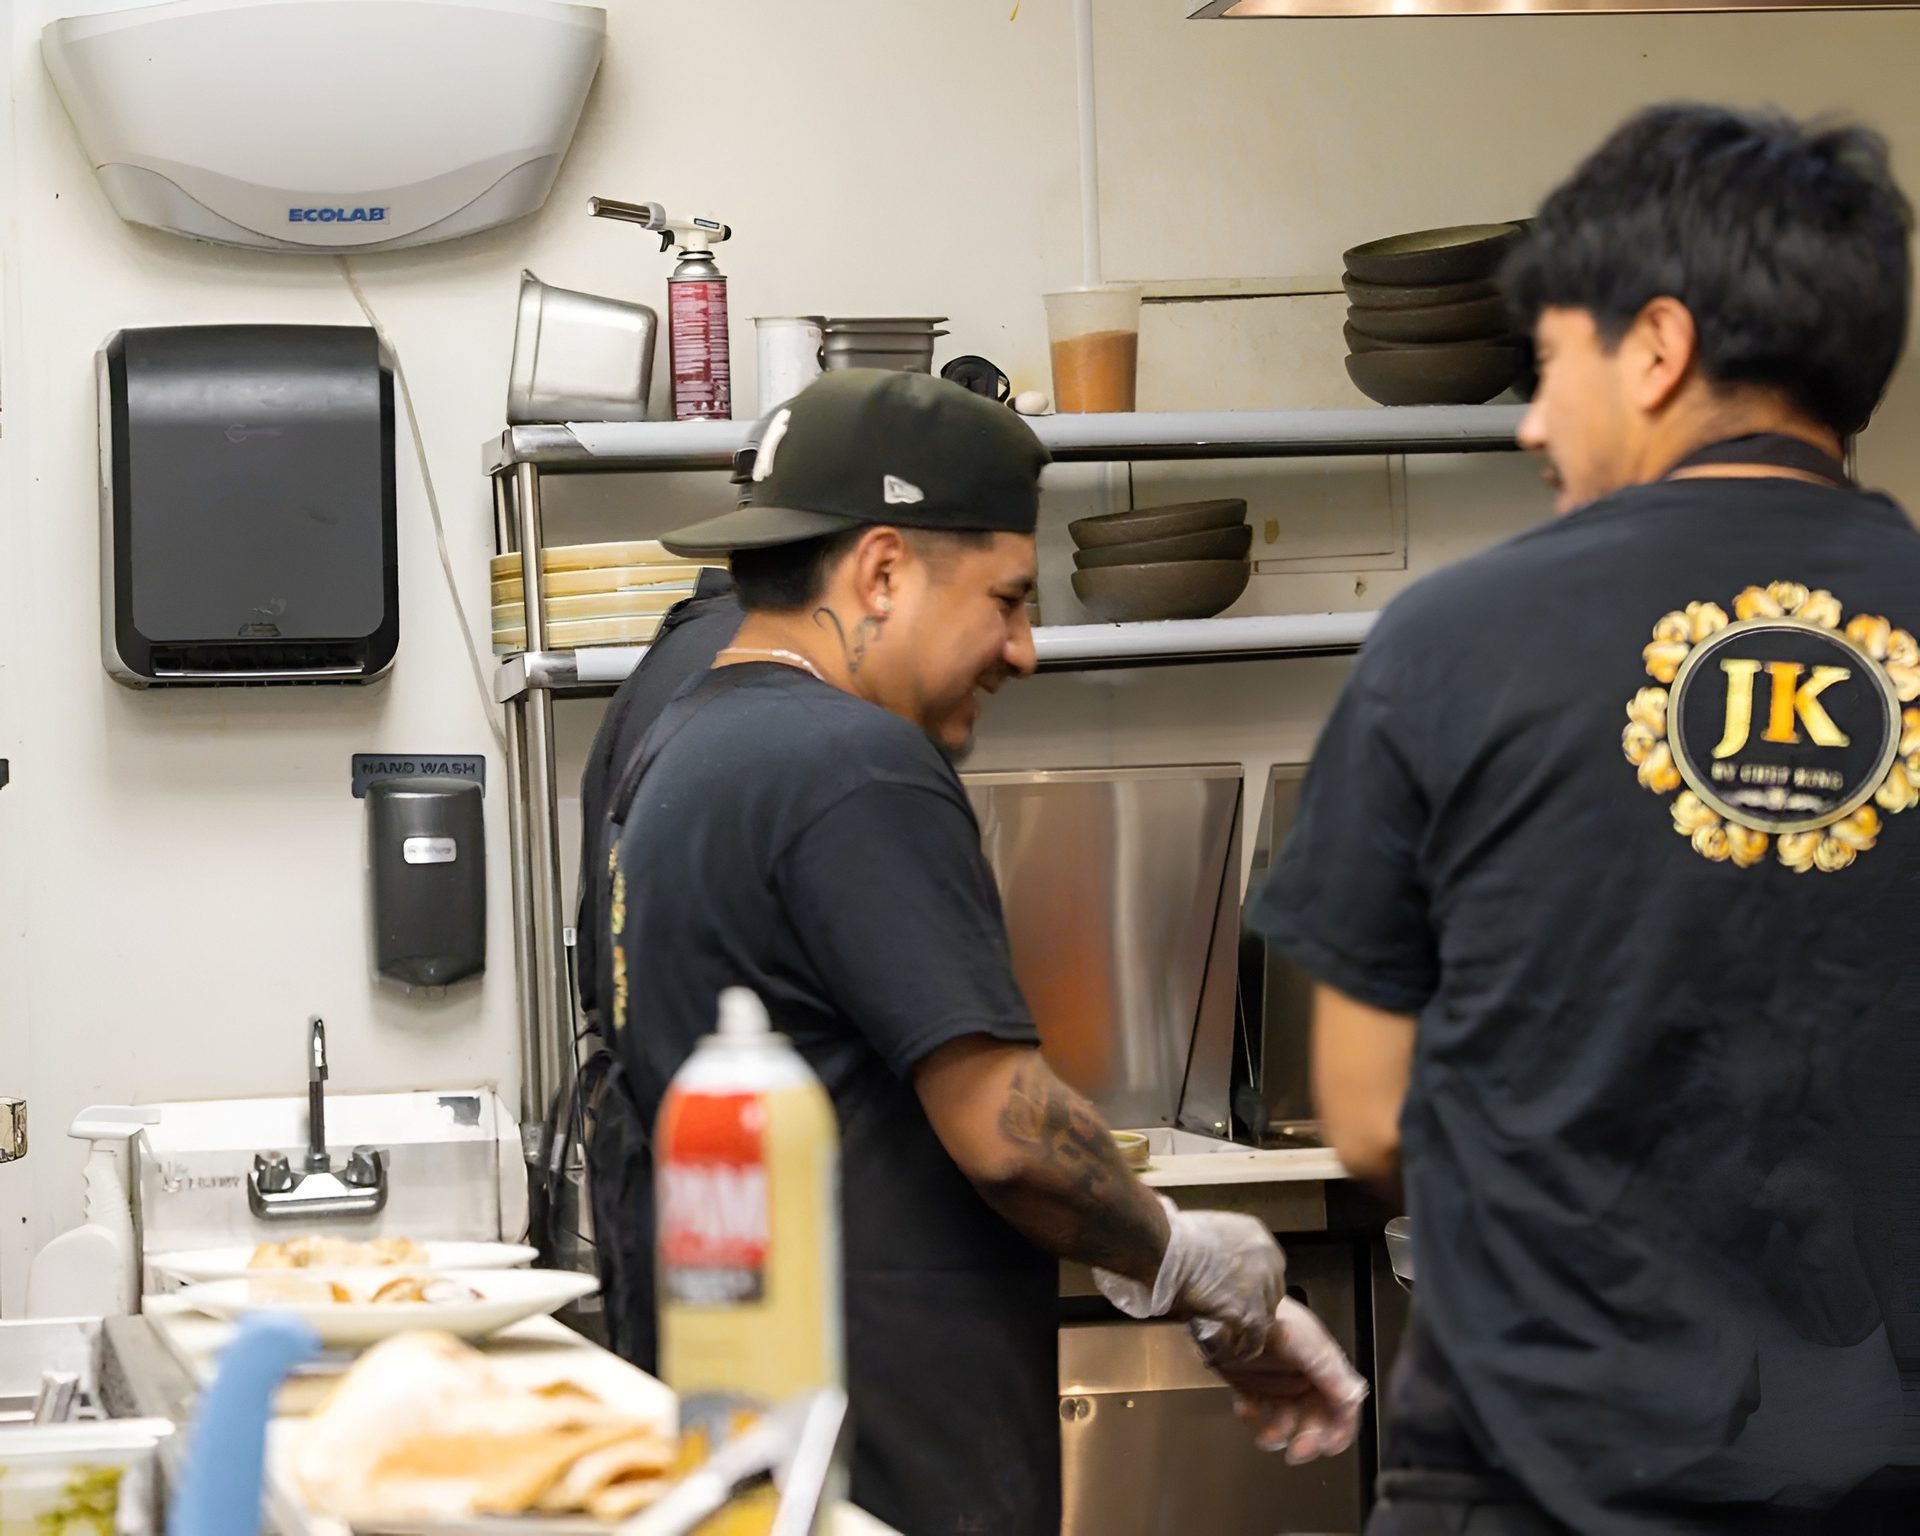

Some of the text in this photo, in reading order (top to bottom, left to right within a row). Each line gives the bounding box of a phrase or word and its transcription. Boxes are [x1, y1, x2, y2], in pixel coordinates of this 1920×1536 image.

[289, 207, 385, 222] ECOLAB
[362, 762, 476, 775] HAND WASH
